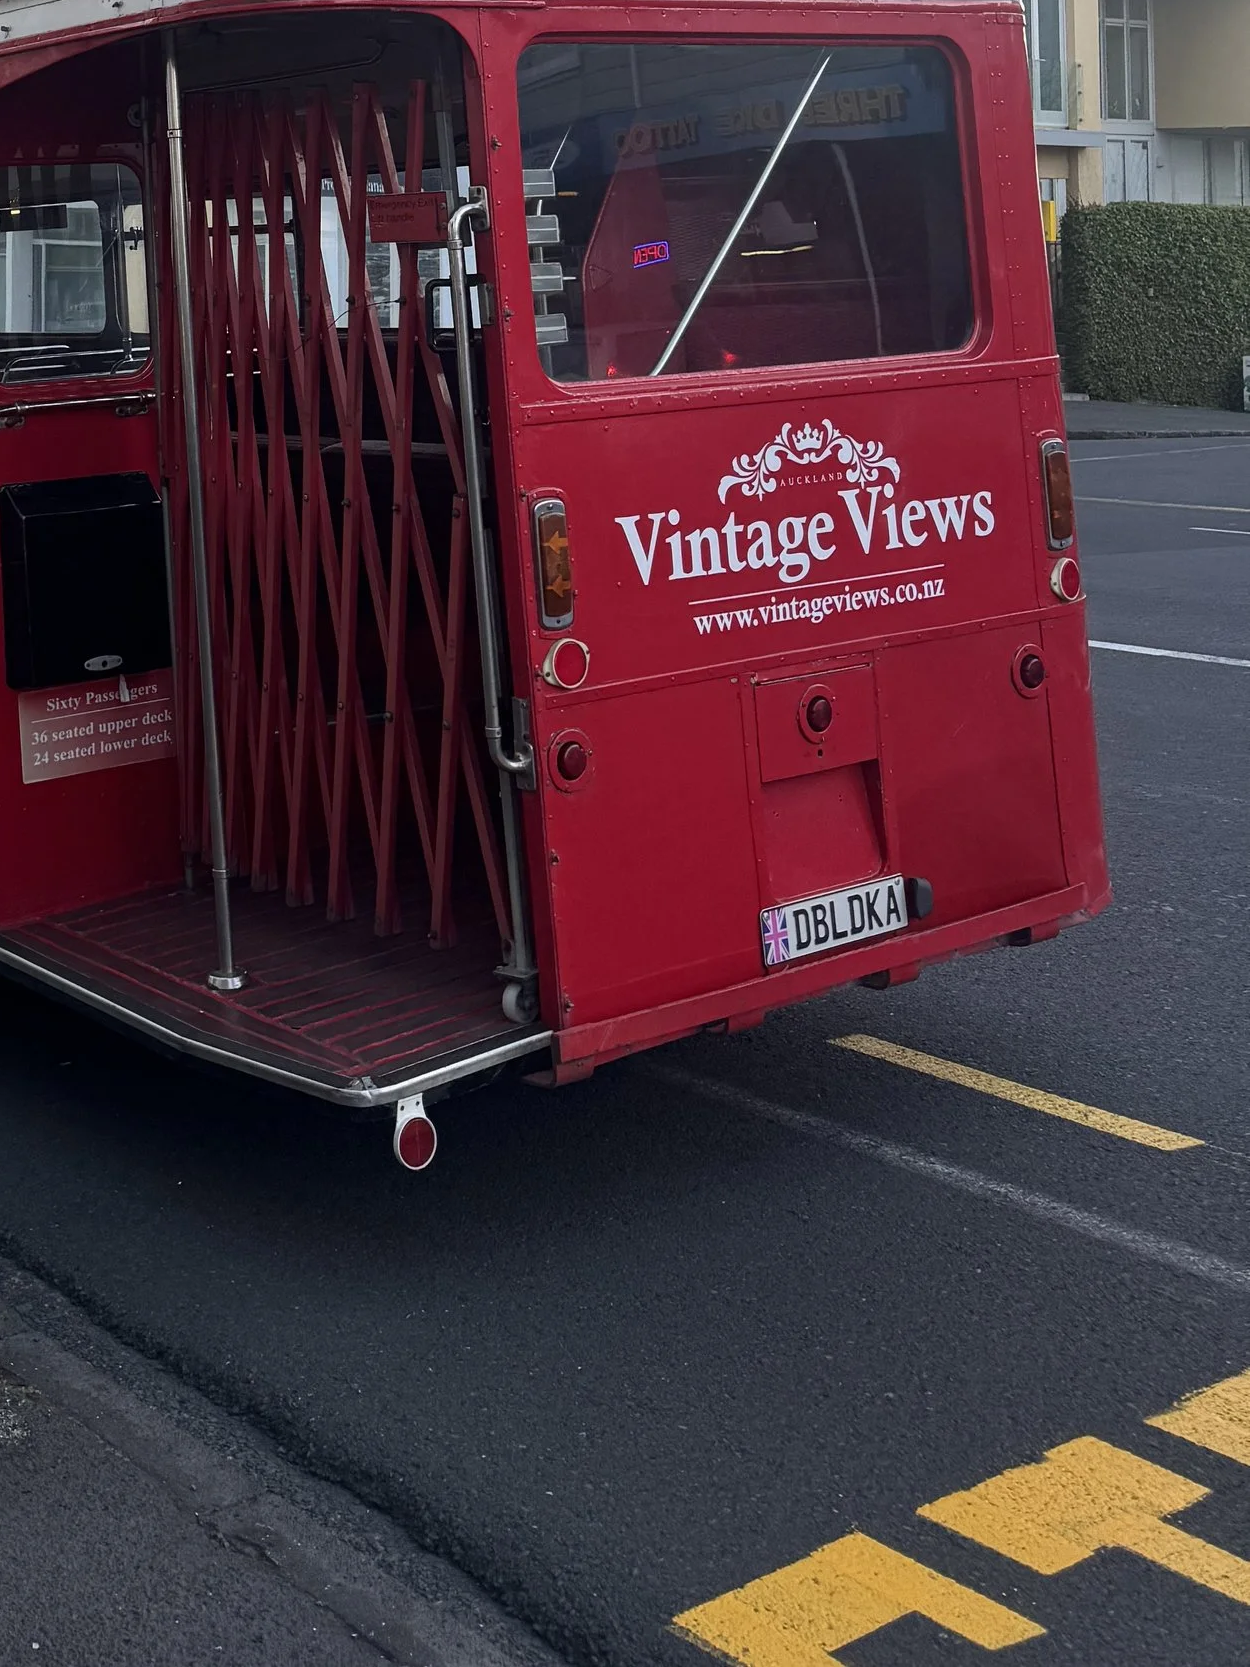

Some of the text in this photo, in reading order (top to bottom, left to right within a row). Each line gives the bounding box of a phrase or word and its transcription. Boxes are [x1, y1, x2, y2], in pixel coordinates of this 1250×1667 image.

[370, 197, 435, 211] Emergency Exit
[780, 471, 843, 487] AUCKLAND
[614, 483, 995, 587] Vintage Views
[693, 576, 945, 635] www.vintageviews.co.nz
[46, 684, 158, 712] Sixty Passegers
[31, 709, 172, 745] 36 seated upper deck
[33, 730, 172, 766] 24 seated lower deck
[793, 885, 901, 950] DBLDKA
